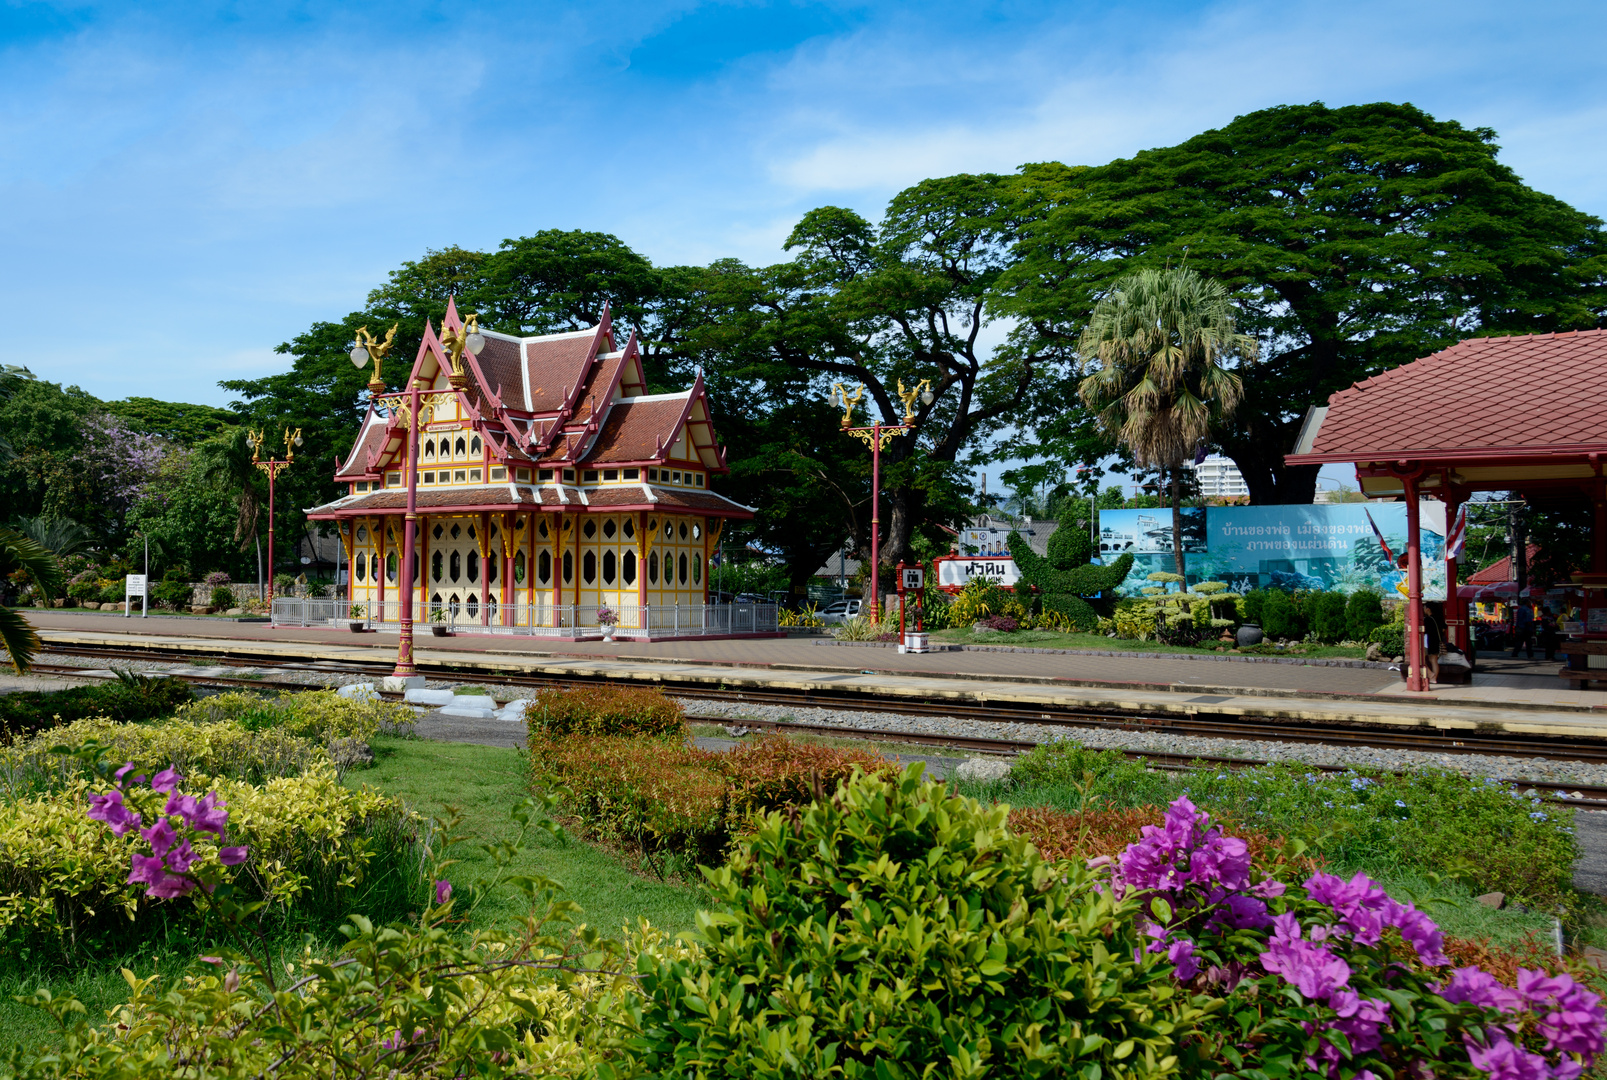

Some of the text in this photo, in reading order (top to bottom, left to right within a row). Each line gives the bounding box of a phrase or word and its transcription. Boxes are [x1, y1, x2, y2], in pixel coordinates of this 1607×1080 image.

[1222, 520, 1373, 536] บ้านของพ่อ เมืองของพ่อ
[1246, 536, 1348, 551] ภาพของแผ่นดิน
[965, 561, 1006, 575] หัวหิน
